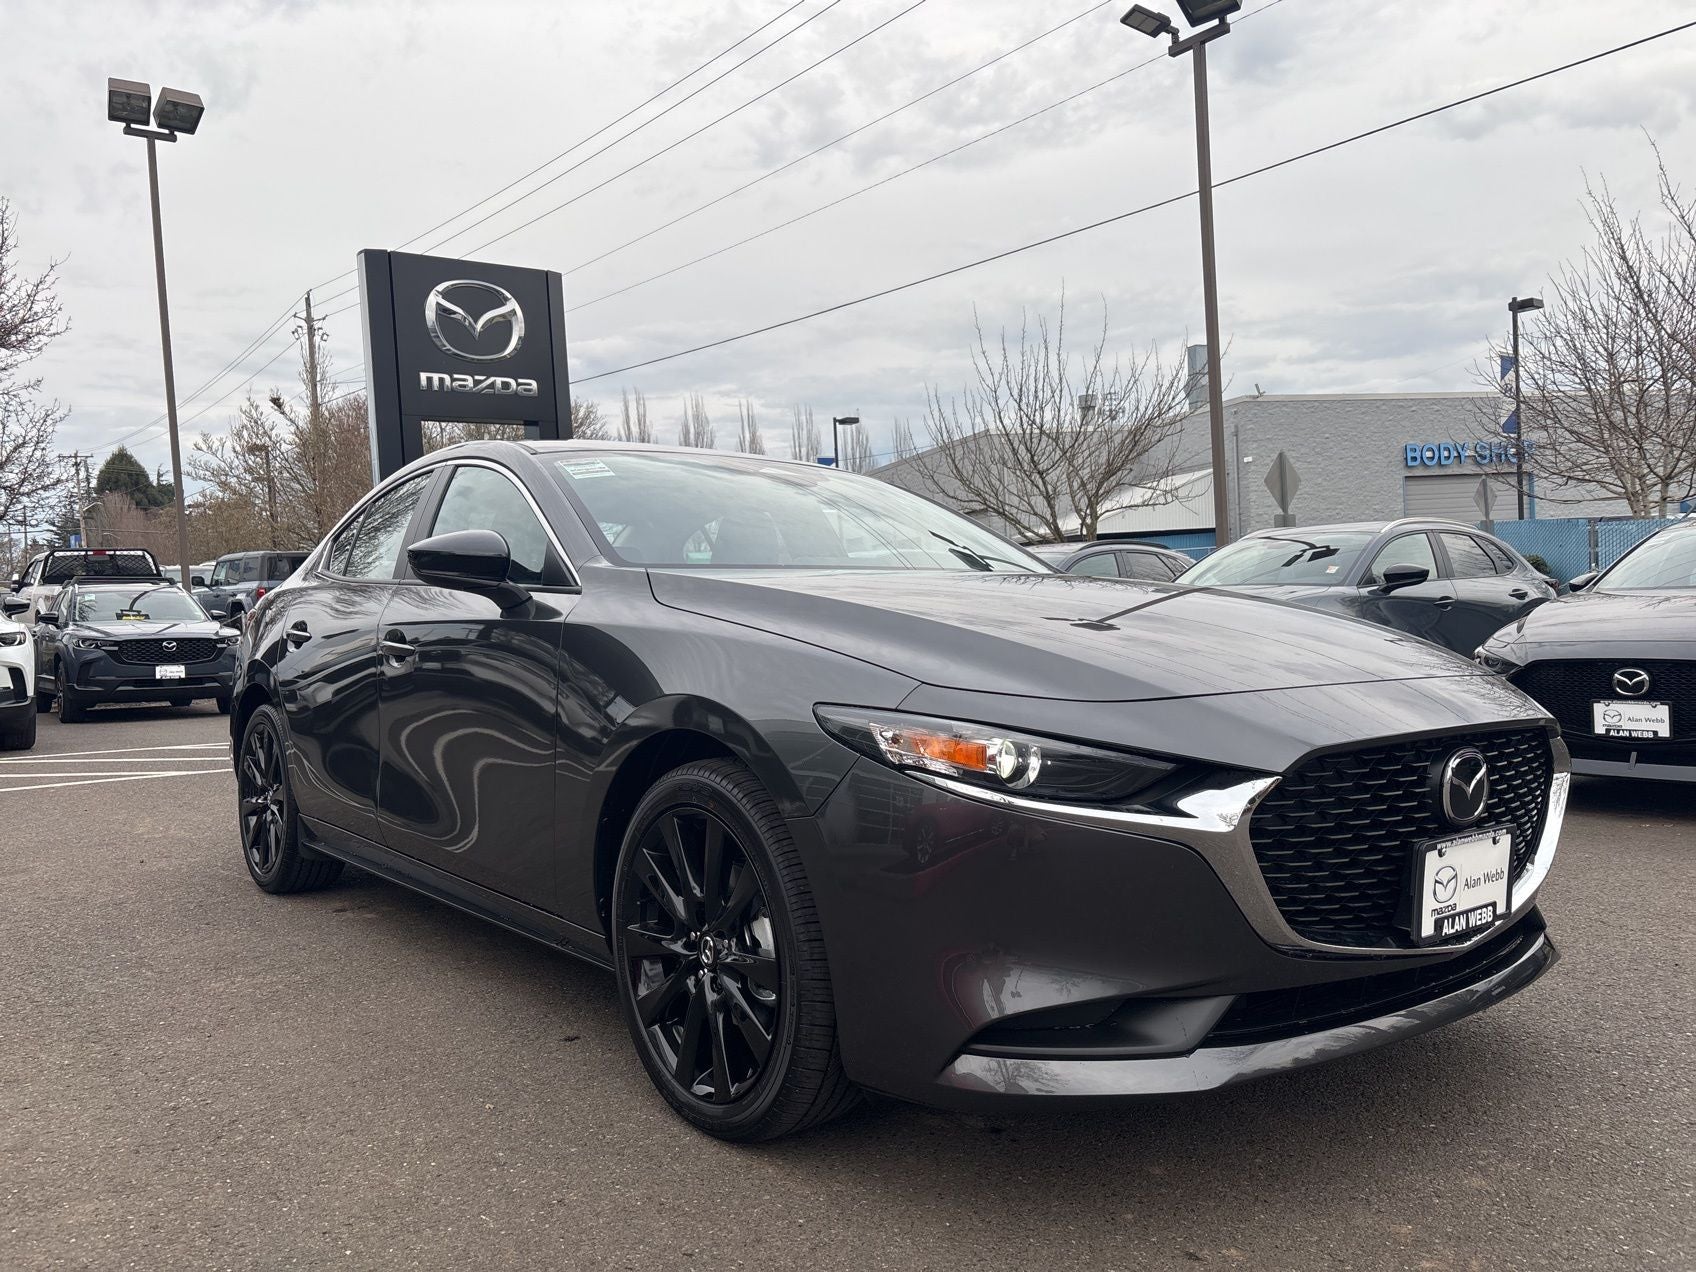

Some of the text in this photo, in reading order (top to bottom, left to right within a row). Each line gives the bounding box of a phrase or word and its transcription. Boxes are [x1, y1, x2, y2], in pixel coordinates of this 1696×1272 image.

[419, 371, 539, 397] mazda
[1404, 441, 1470, 467] BODY
[1609, 729, 1629, 737] ALAN
[1463, 867, 1505, 892] Alan Webb
[1430, 903, 1457, 918] mazda
[1441, 905, 1494, 937] ALAN WEBB
